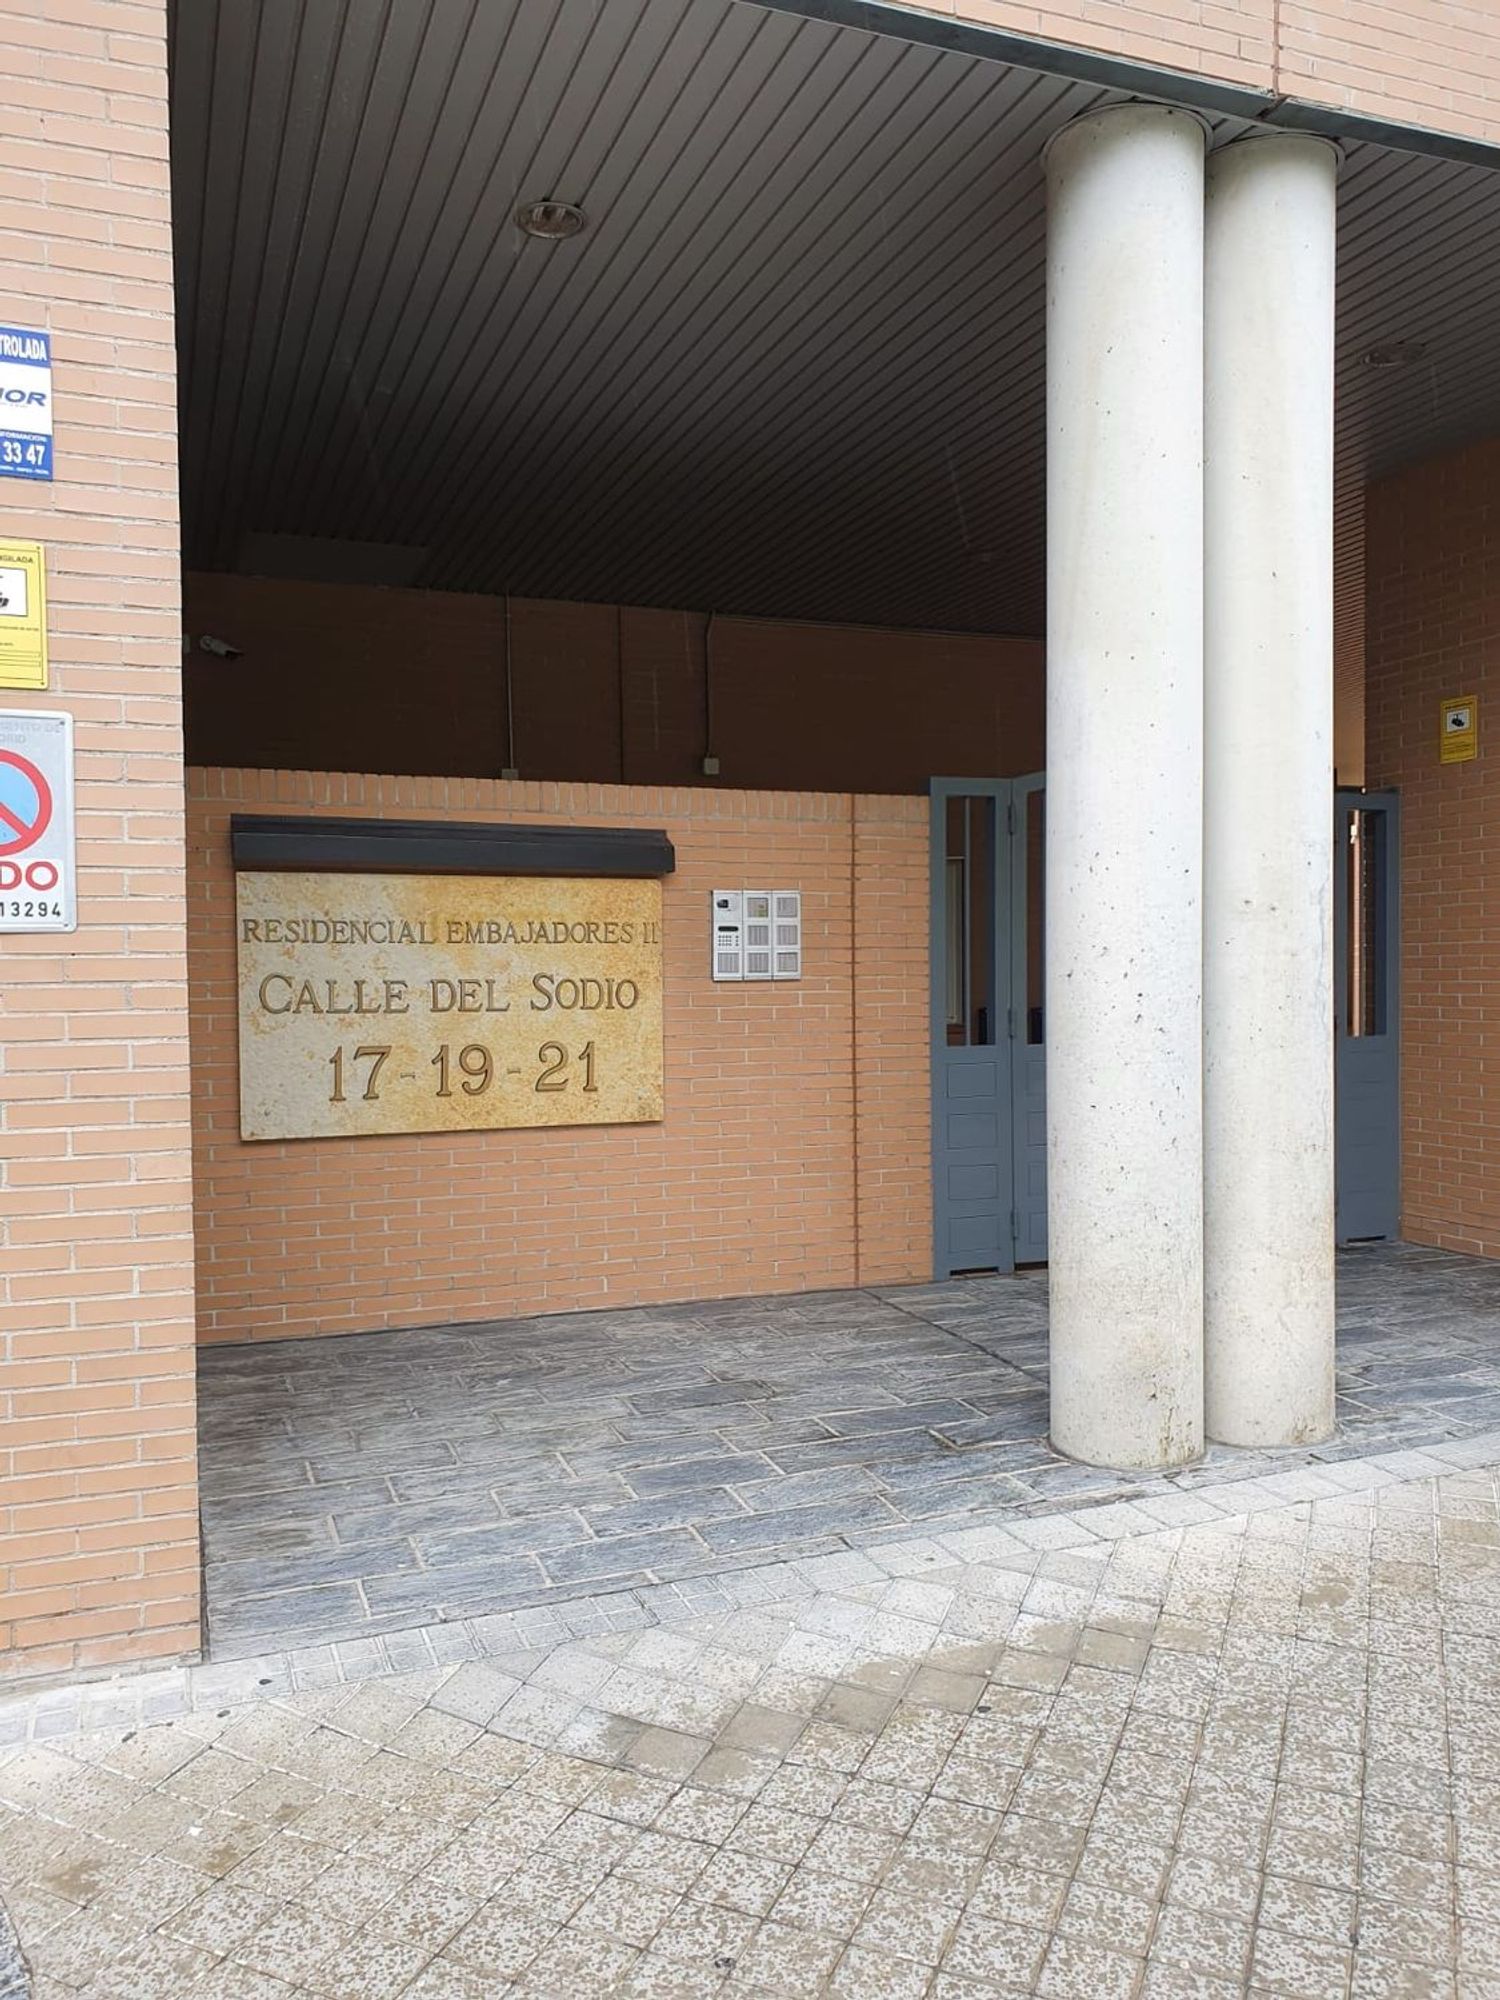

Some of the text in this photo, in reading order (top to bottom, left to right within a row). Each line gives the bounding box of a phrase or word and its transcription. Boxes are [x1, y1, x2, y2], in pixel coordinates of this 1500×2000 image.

[3, 440, 46, 466] 33 47
[0, 861, 59, 891] DO
[0, 901, 61, 918] 13294
[242, 919, 436, 945] RESIDENCIAL
[446, 920, 633, 945] EMBAJADORES
[258, 972, 640, 1015] CALLE DEL SODIO
